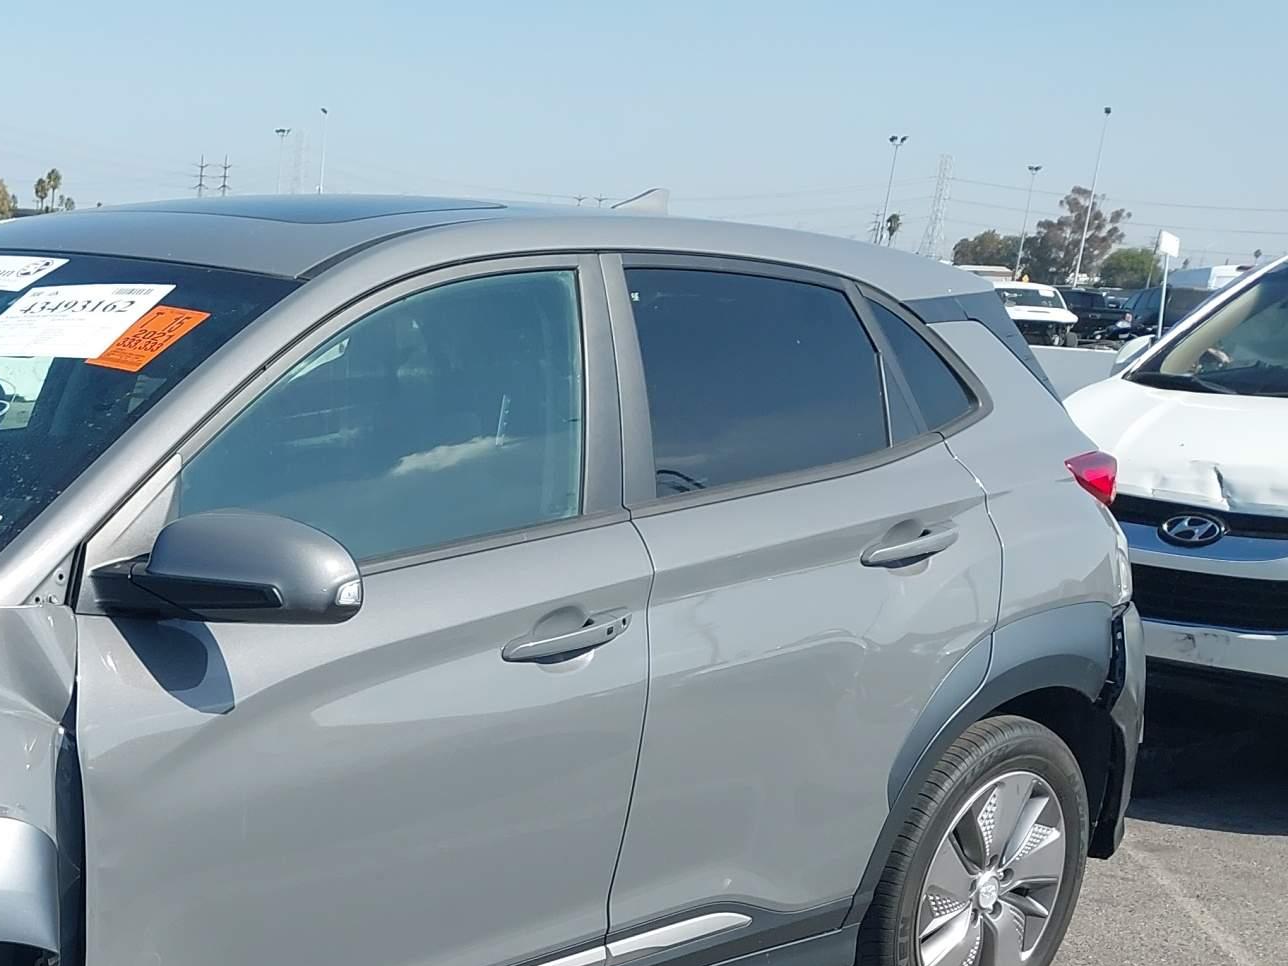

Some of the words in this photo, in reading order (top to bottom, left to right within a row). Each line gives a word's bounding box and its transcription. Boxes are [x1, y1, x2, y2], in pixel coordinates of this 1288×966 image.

[20, 300, 135, 314] 43493162
[162, 315, 192, 333] 15
[133, 329, 175, 343] 2021
[116, 336, 164, 353] 333,333
